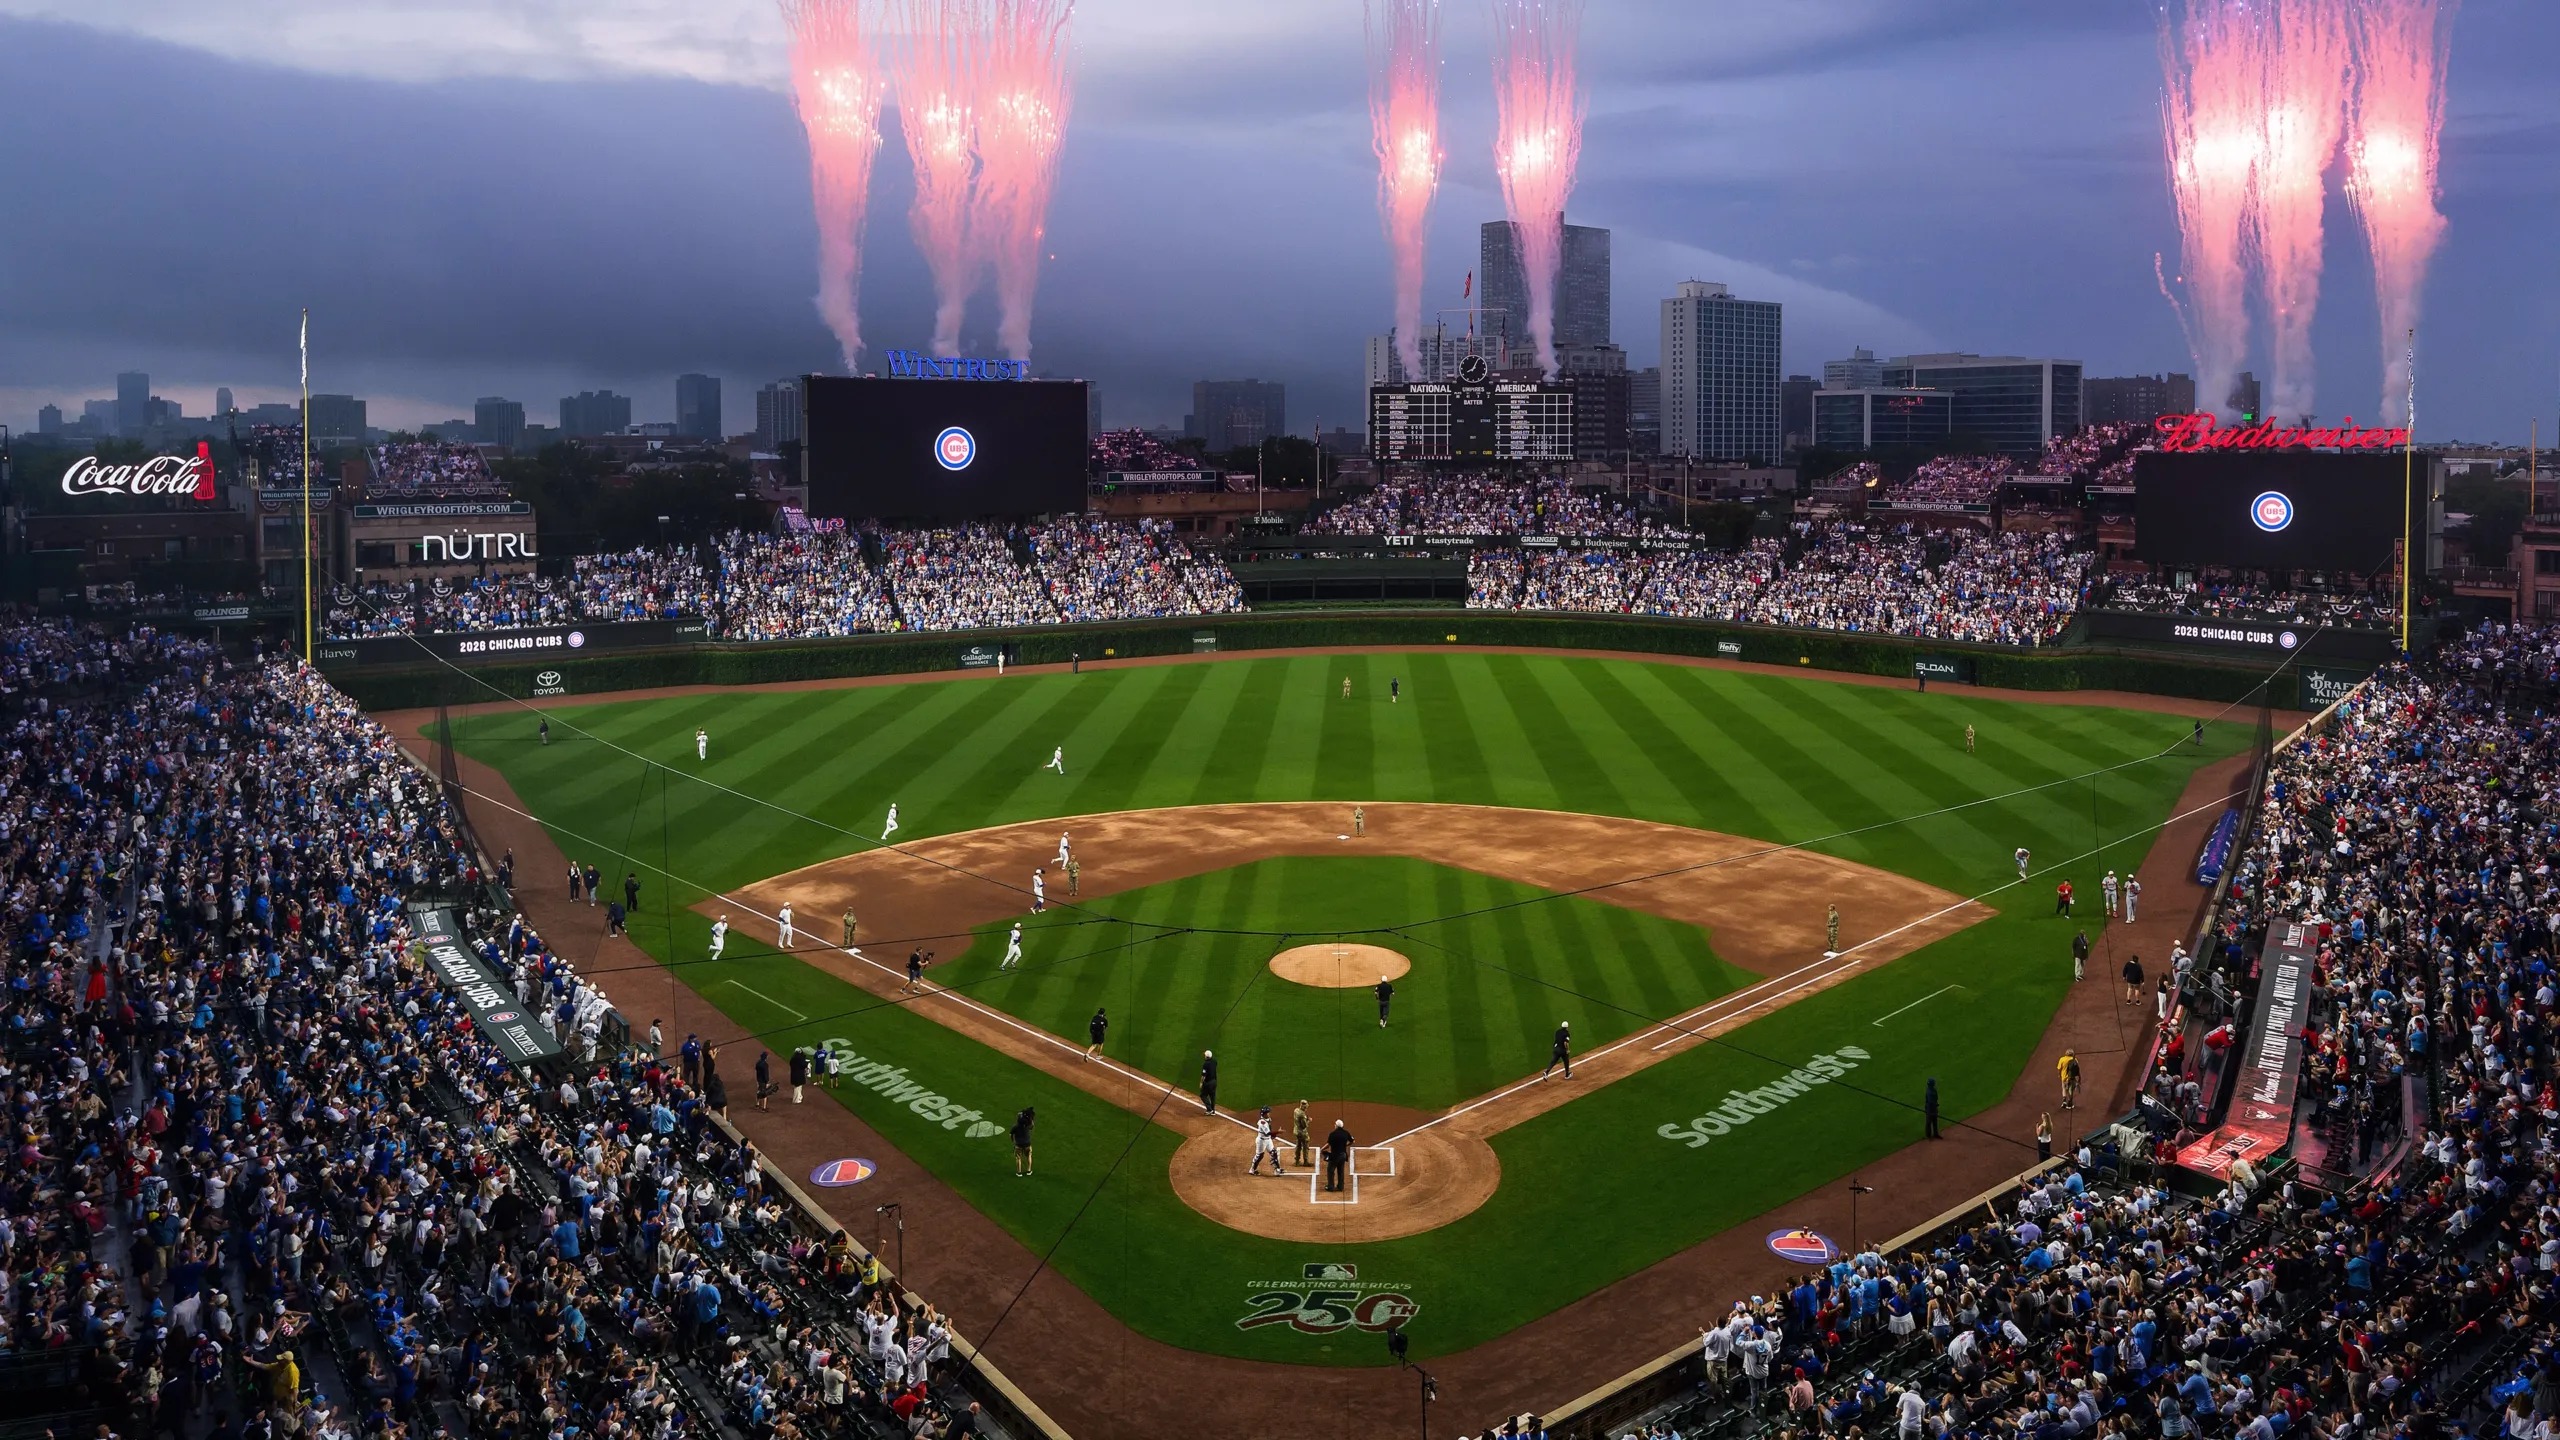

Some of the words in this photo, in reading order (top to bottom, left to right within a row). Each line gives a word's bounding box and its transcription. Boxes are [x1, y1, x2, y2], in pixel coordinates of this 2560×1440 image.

[886, 350, 1030, 380] WINTRUST
[1410, 384, 1452, 392] NATIONAL
[1495, 384, 1537, 392] AMERICAN
[2156, 412, 2412, 452] Budweiser
[62, 456, 208, 495] Coca-Cola
[377, 504, 510, 515] WRIGLEYROOFTOPS.COM
[1892, 502, 1964, 510] WRIGLEYROOFTOPS.COM
[1383, 536, 1414, 546] YETI
[1431, 537, 1474, 545] tastytrade
[1585, 539, 1628, 547] Budweiser
[1652, 540, 1690, 548] Advocate
[194, 607, 249, 616] GRAINGER
[2174, 625, 2198, 637] 2026
[2201, 628, 2244, 642] CHICAGO
[2247, 631, 2274, 644] CUBS
[460, 641, 486, 653] 2026
[488, 638, 533, 650] CHICAGO
[536, 636, 562, 647] CUBS
[1720, 644, 1739, 652] Hefty
[320, 650, 357, 658] Harvey
[1916, 662, 1954, 673] SLOAN
[534, 687, 564, 696] TOYOTA
[430, 946, 481, 982] CHICAGO
[2277, 964, 2299, 979] FIELD
[2273, 977, 2297, 999] WRIGLEY
[507, 1024, 544, 1055] WINTRUST
[2258, 1057, 2284, 1071] THE
[804, 1038, 984, 1130] Southwest
[2252, 1078, 2280, 1104] Welcome
[1657, 1054, 1859, 1148] Southwest
[2189, 1132, 2257, 1168] WINTRUST
[1247, 1280, 1336, 1289] CELEBRATING
